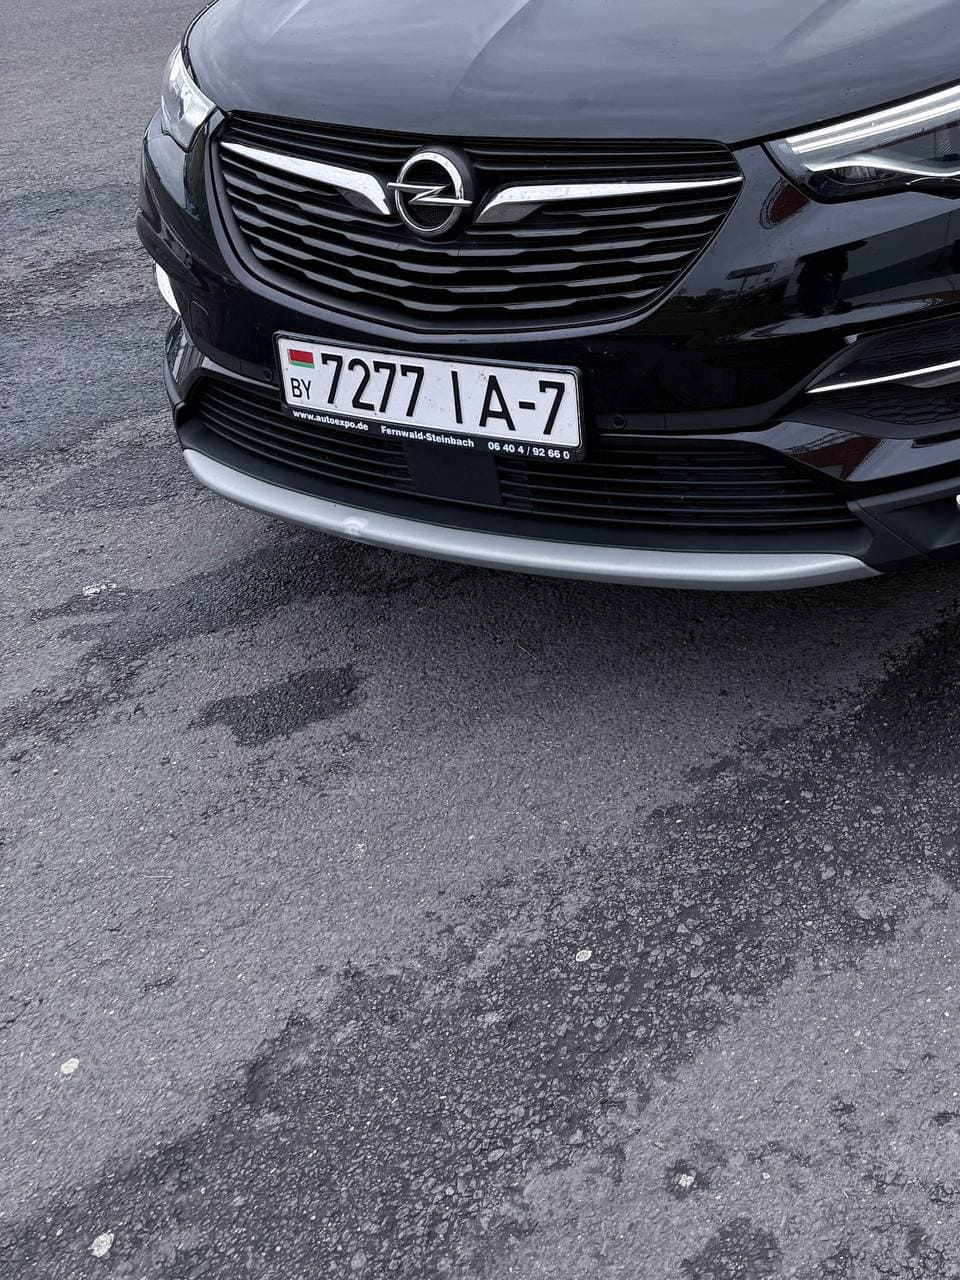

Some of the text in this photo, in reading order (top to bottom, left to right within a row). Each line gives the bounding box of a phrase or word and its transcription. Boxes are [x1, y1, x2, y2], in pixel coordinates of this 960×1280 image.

[291, 377, 312, 399] BY
[320, 352, 425, 417] 7277
[292, 409, 369, 431] www.autoexpo.de
[381, 425, 475, 448] Fernwald-Steinbach
